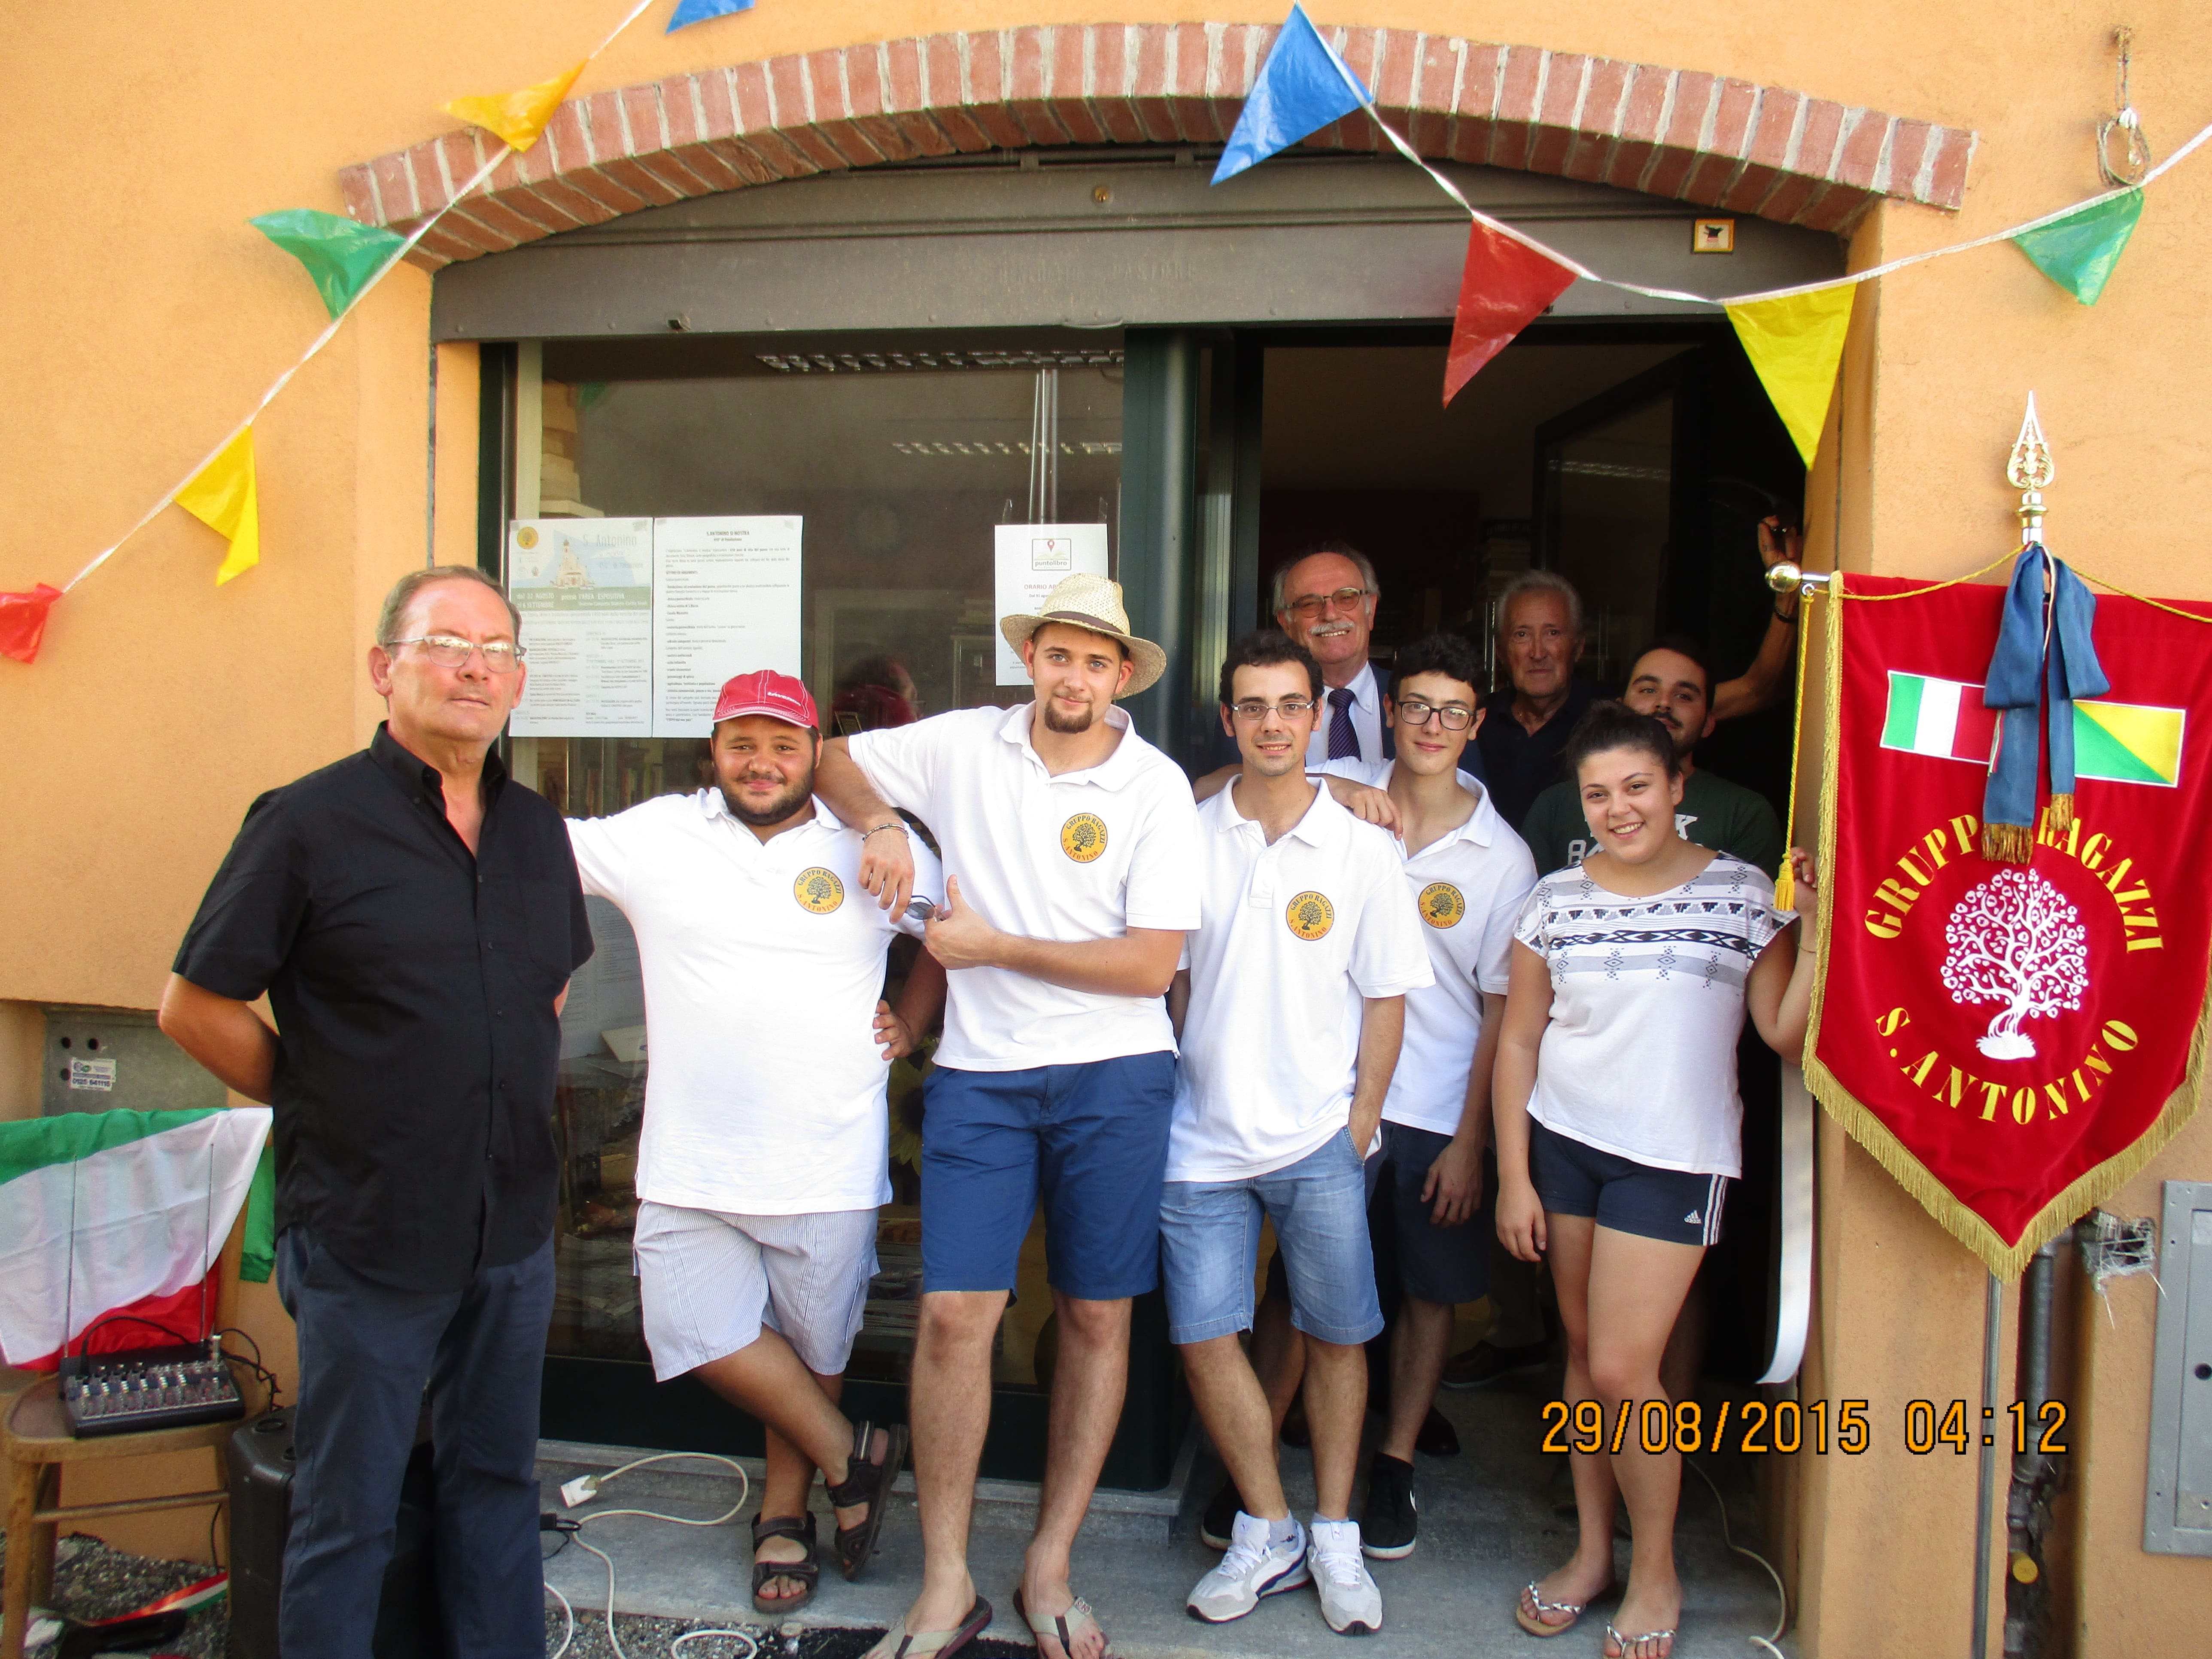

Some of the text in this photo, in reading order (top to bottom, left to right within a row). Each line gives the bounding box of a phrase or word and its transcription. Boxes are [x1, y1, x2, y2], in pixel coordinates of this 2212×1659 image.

[596, 534, 637, 547] Antonino
[1066, 815, 1091, 830] GRUPPO
[798, 870, 821, 886] GRUPPO
[1865, 806, 2164, 953] GRUPP RAGAZZI
[1425, 885, 1451, 895] GRUPPO
[1290, 894, 1313, 911] GRUPPO
